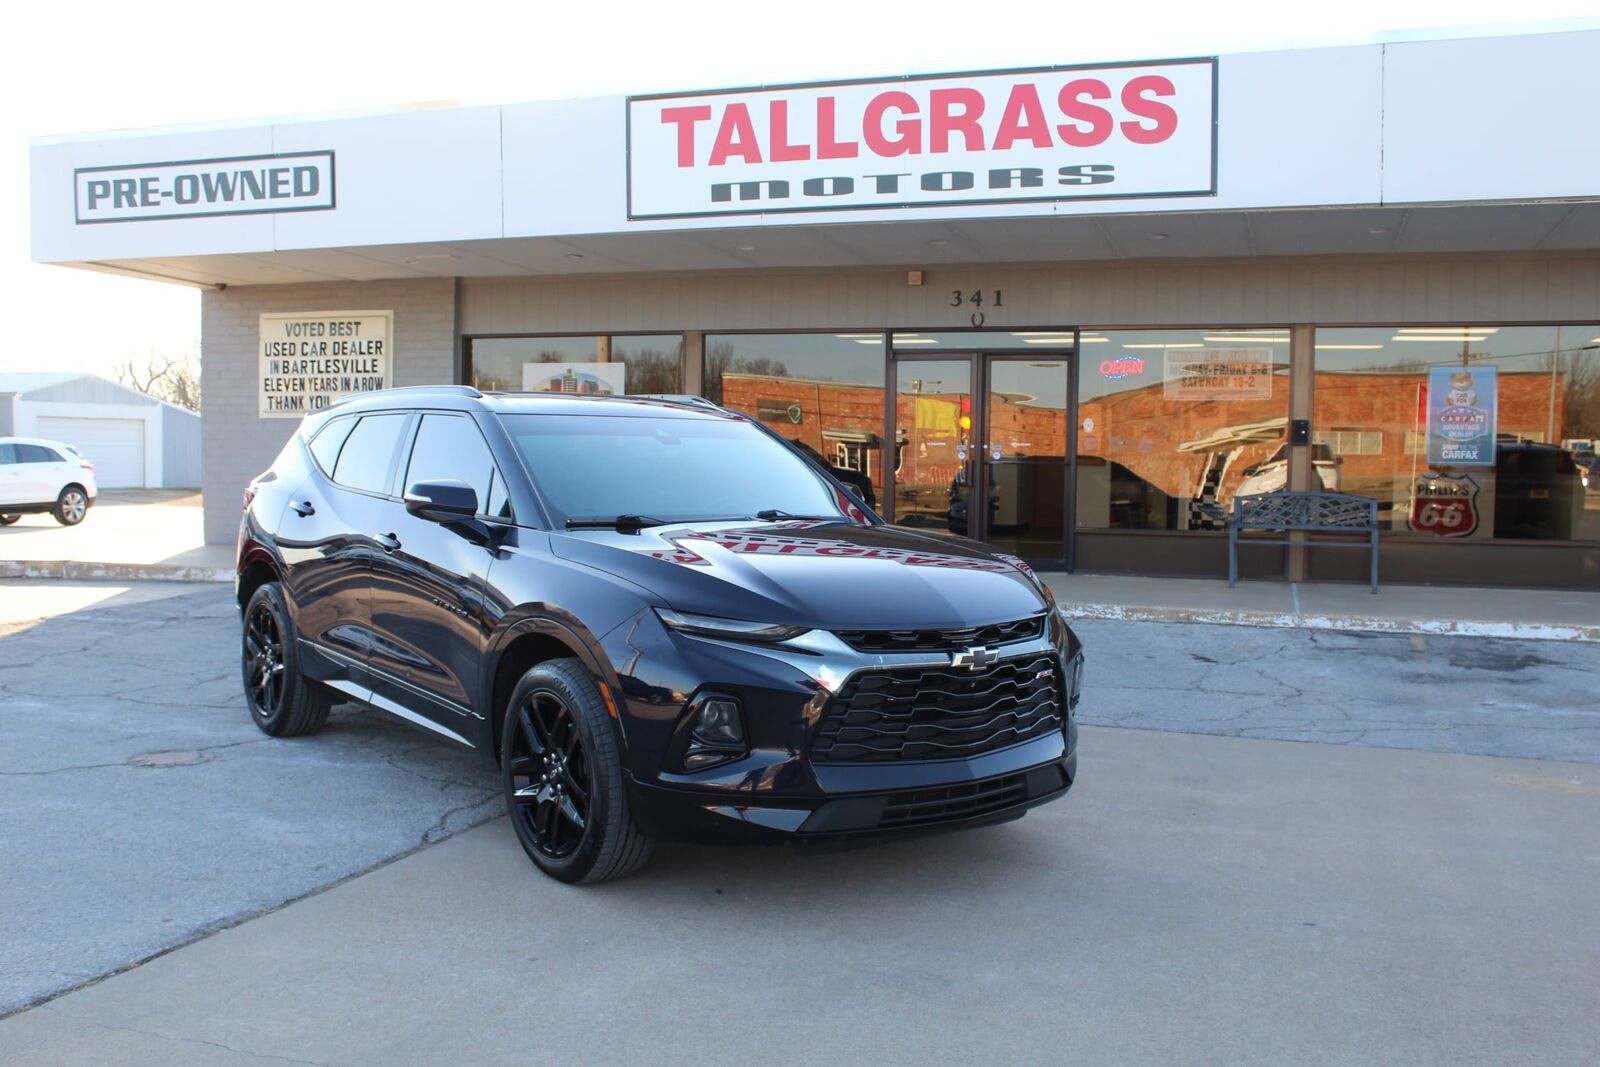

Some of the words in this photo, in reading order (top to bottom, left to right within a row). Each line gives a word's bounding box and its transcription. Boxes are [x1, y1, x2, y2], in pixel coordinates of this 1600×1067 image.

[661, 74, 1178, 168] TALLGRASS
[87, 165, 320, 210] PRE-OWNED
[711, 164, 1115, 202] MOTORS
[285, 322, 325, 337] VOTED
[329, 321, 361, 336] BEST
[265, 342, 296, 356] USED
[301, 341, 327, 356] CAR
[333, 340, 383, 355] DEALER
[270, 360, 279, 374] IN
[282, 359, 378, 374] BARTLESVILLE
[1099, 360, 1145, 375] OPEN
[264, 378, 305, 392] ELEVEN
[308, 377, 338, 391] YEARS
[341, 377, 350, 391] IN
[353, 377, 360, 391] A
[362, 376, 383, 391] ROW
[1182, 376, 1230, 388] SATURDAY
[1233, 375, 1255, 388] 10-2
[267, 395, 304, 410] THANK
[308, 395, 330, 409] YOU
[1442, 450, 1479, 459] CARFAX
[1420, 503, 1465, 527] 66
